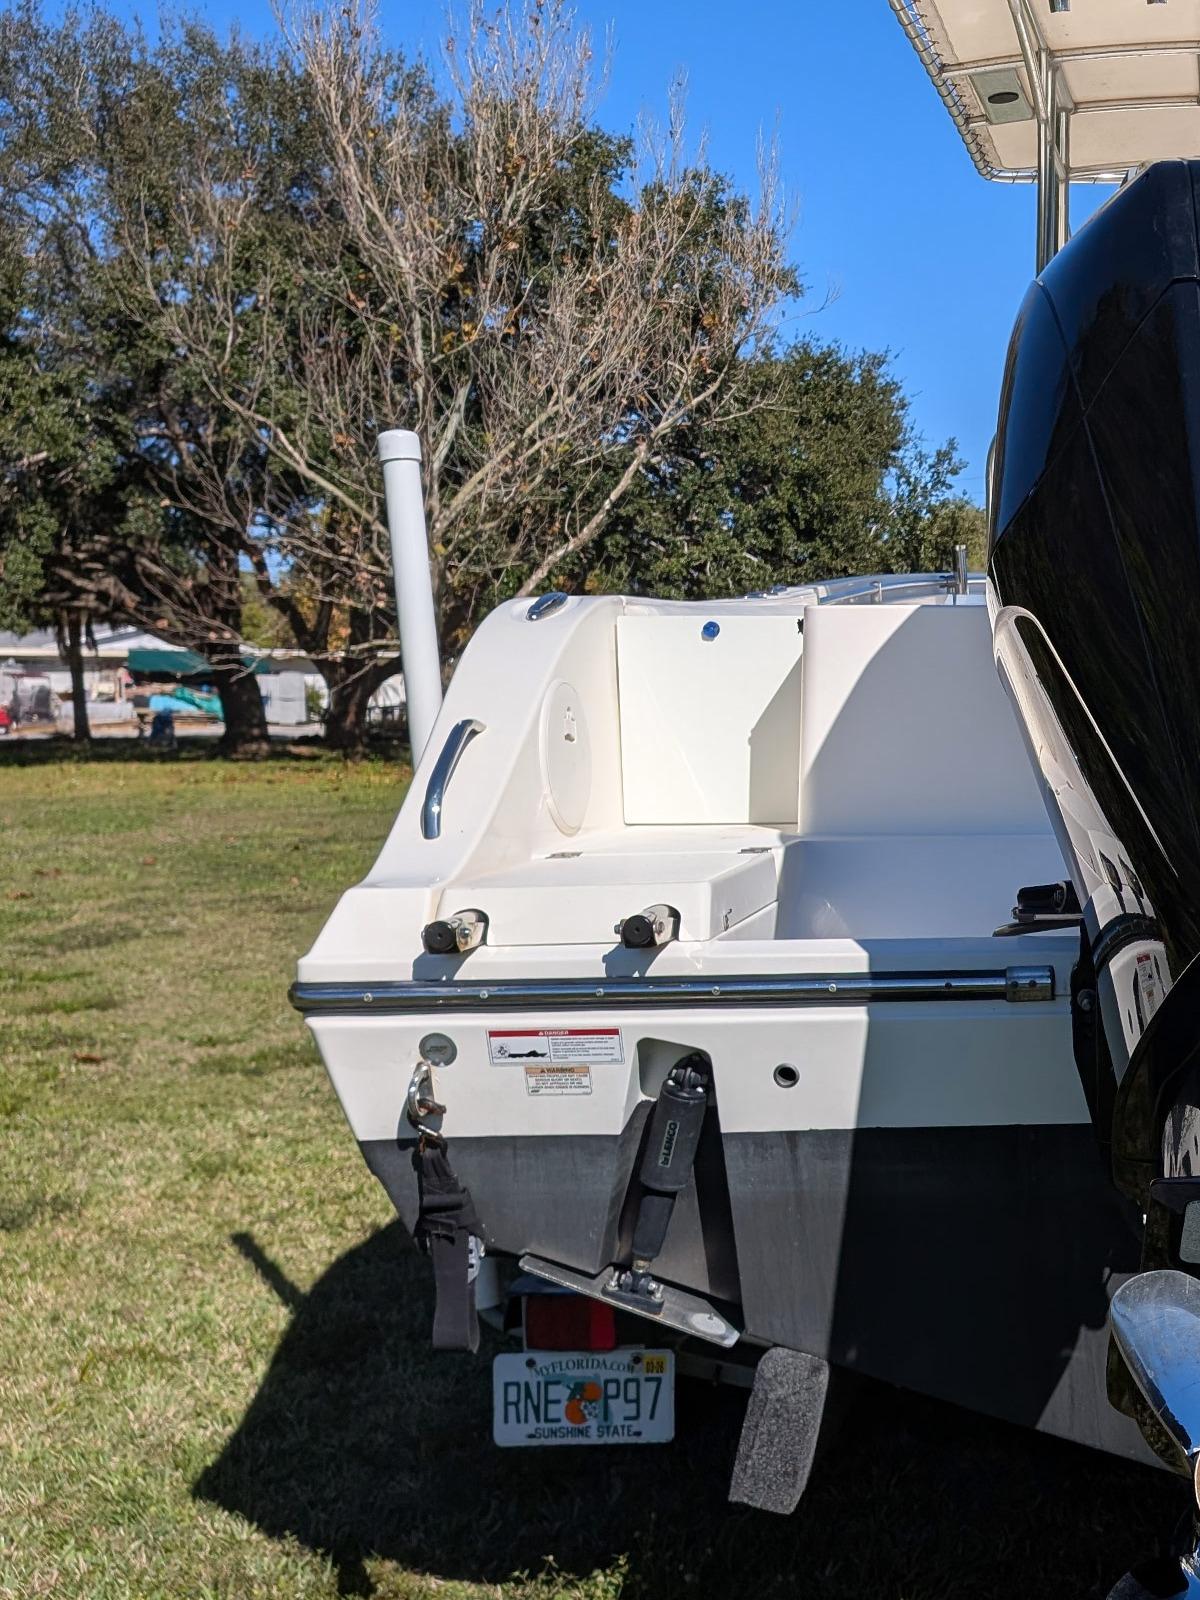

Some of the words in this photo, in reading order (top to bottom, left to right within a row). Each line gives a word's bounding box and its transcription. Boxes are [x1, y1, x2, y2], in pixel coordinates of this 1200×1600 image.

[662, 1122, 677, 1156] LENCO
[534, 1357, 636, 1377] MYFLORIDA.COM
[503, 1380, 562, 1424] RNE
[603, 1376, 663, 1422] P97
[534, 1426, 591, 1439] SUNSHINE
[597, 1424, 633, 1437] STATE
